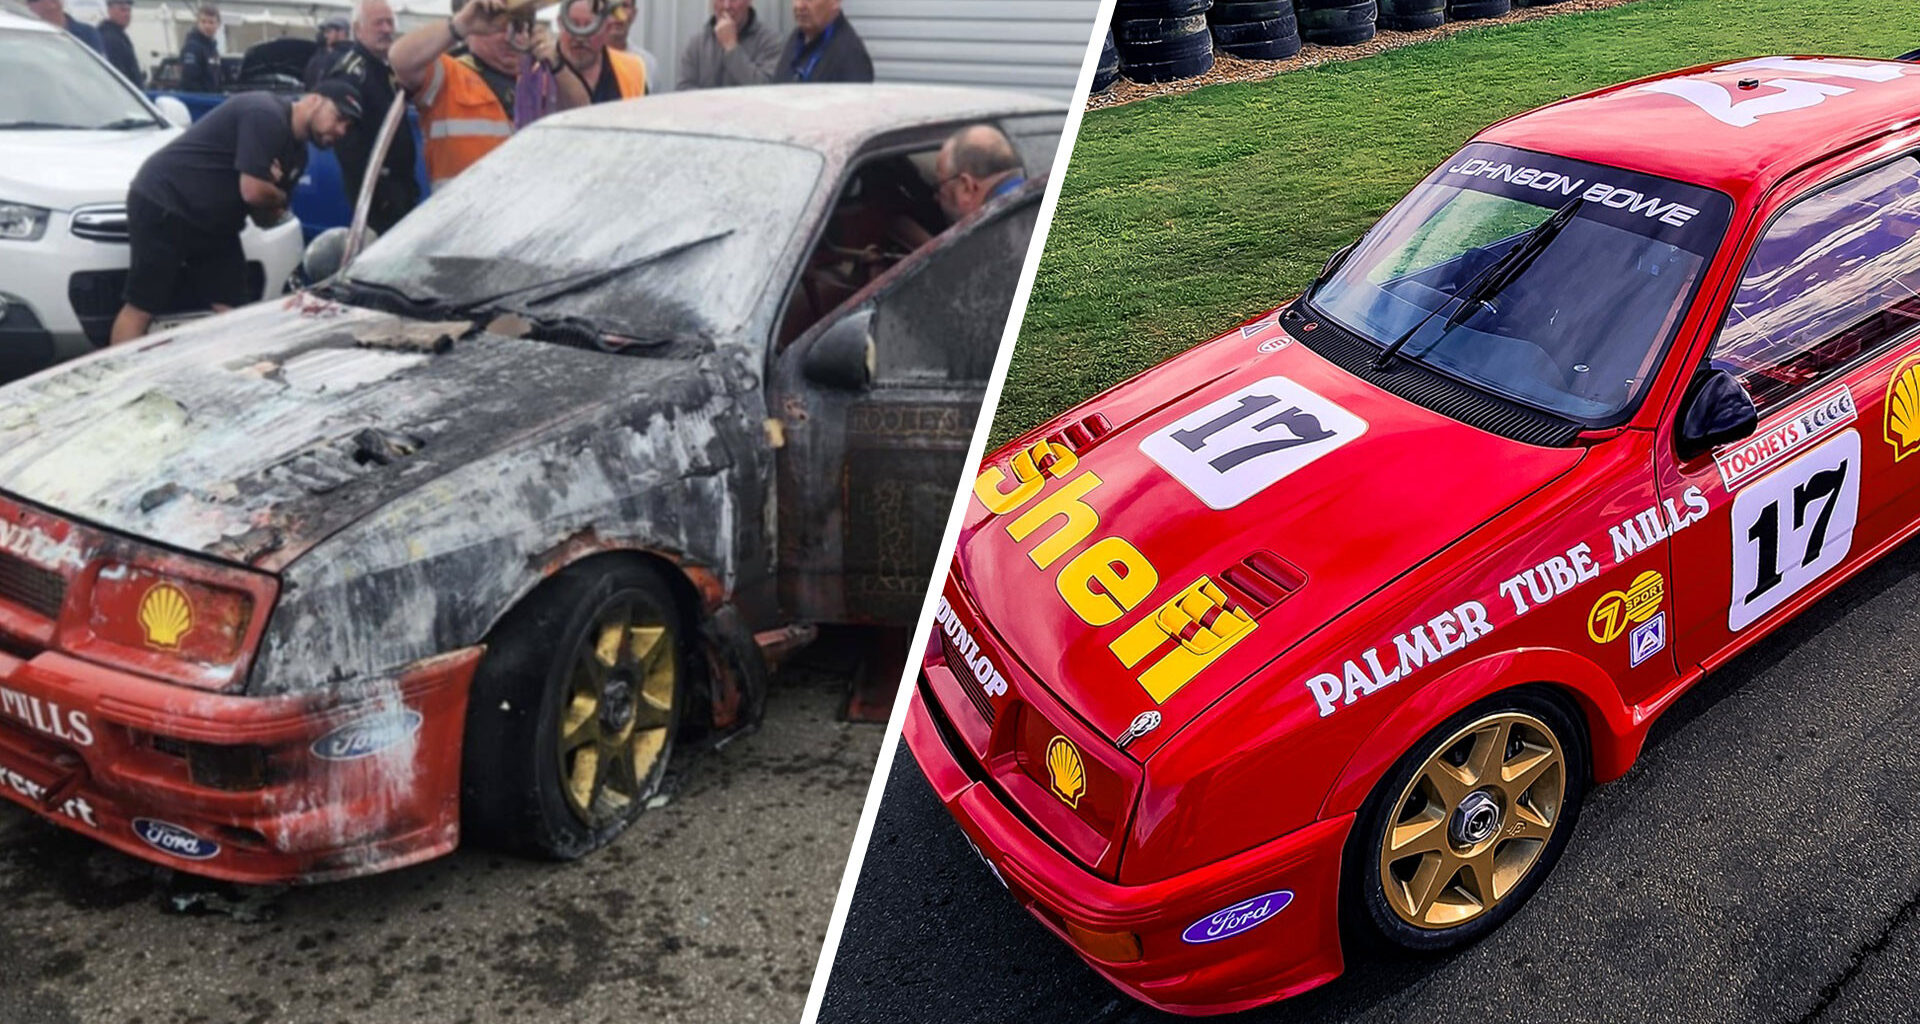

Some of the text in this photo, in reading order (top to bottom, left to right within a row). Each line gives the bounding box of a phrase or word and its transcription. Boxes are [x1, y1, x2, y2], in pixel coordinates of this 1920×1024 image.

[1447, 157, 1701, 228] JOHNSON BOWE
[1169, 394, 1338, 475] 17
[1720, 423, 1799, 480] TOOHEYS
[1743, 457, 1850, 606] 17
[972, 438, 1260, 706] Shell
[1305, 485, 1710, 718] PALMER TUBE MILLS
[1624, 583, 1664, 612] SPORT
[935, 594, 1008, 698] DUNLOP
[146, 819, 202, 854] Ford
[1206, 898, 1272, 937] Ford
